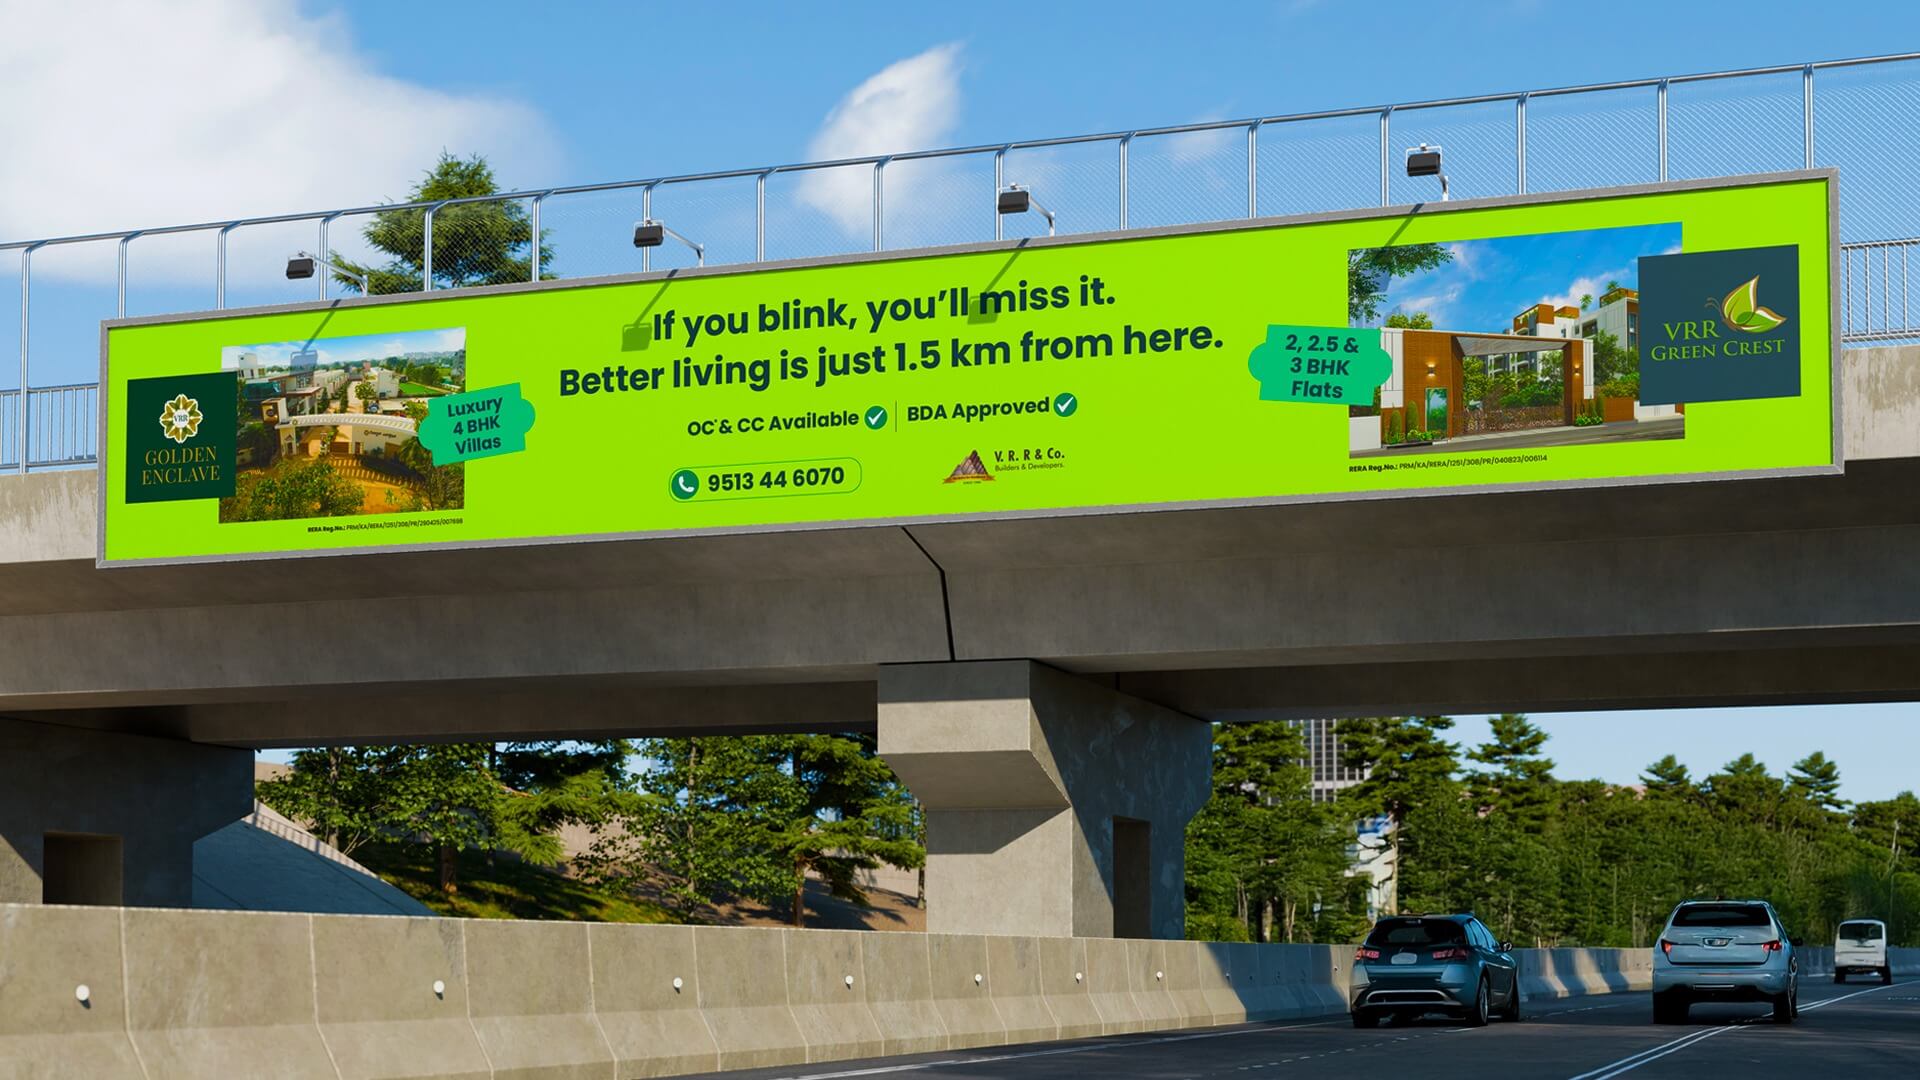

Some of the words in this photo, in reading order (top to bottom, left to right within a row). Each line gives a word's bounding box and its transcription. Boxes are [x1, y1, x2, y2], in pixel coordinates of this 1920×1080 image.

[654, 310, 675, 340] If
[683, 312, 748, 347] you
[759, 298, 857, 332] blink,
[979, 280, 1069, 315] miss
[1080, 275, 1115, 306] it.
[1663, 320, 1720, 340] VRR
[1286, 334, 1302, 353] 2,
[1308, 335, 1338, 352] 2.5
[1344, 338, 1358, 353] &
[560, 366, 664, 396] Better
[674, 355, 770, 391] living
[780, 349, 808, 380] is
[816, 346, 885, 387] just
[895, 340, 940, 371] 1.5
[952, 338, 1010, 367] km
[1020, 331, 1112, 362] from
[1124, 325, 1223, 354] here.
[1291, 357, 1302, 373] 3
[1307, 359, 1349, 375] BHK
[1292, 381, 1343, 398] Flats
[448, 397, 503, 417] Luxury
[908, 405, 947, 421] BDA
[952, 397, 1049, 422] Approved
[173, 414, 188, 422] VRR
[453, 422, 463, 435] 4
[467, 415, 500, 433] BHK
[719, 419, 732, 434] &
[738, 417, 764, 432] CC
[769, 411, 859, 430] Available
[455, 437, 501, 454] Villas
[995, 451, 1003, 462] V.
[1008, 450, 1018, 461] R.
[1024, 449, 1030, 460] R
[1035, 449, 1042, 460] &
[1047, 448, 1064, 459] Co.
[145, 446, 216, 466] GOLDEN
[142, 465, 220, 486] ENCLAVE
[995, 464, 1019, 472] Builders
[1349, 465, 1368, 473] RERA
[709, 473, 753, 491] 9513
[760, 471, 787, 488] 44
[793, 467, 844, 486] 6070
